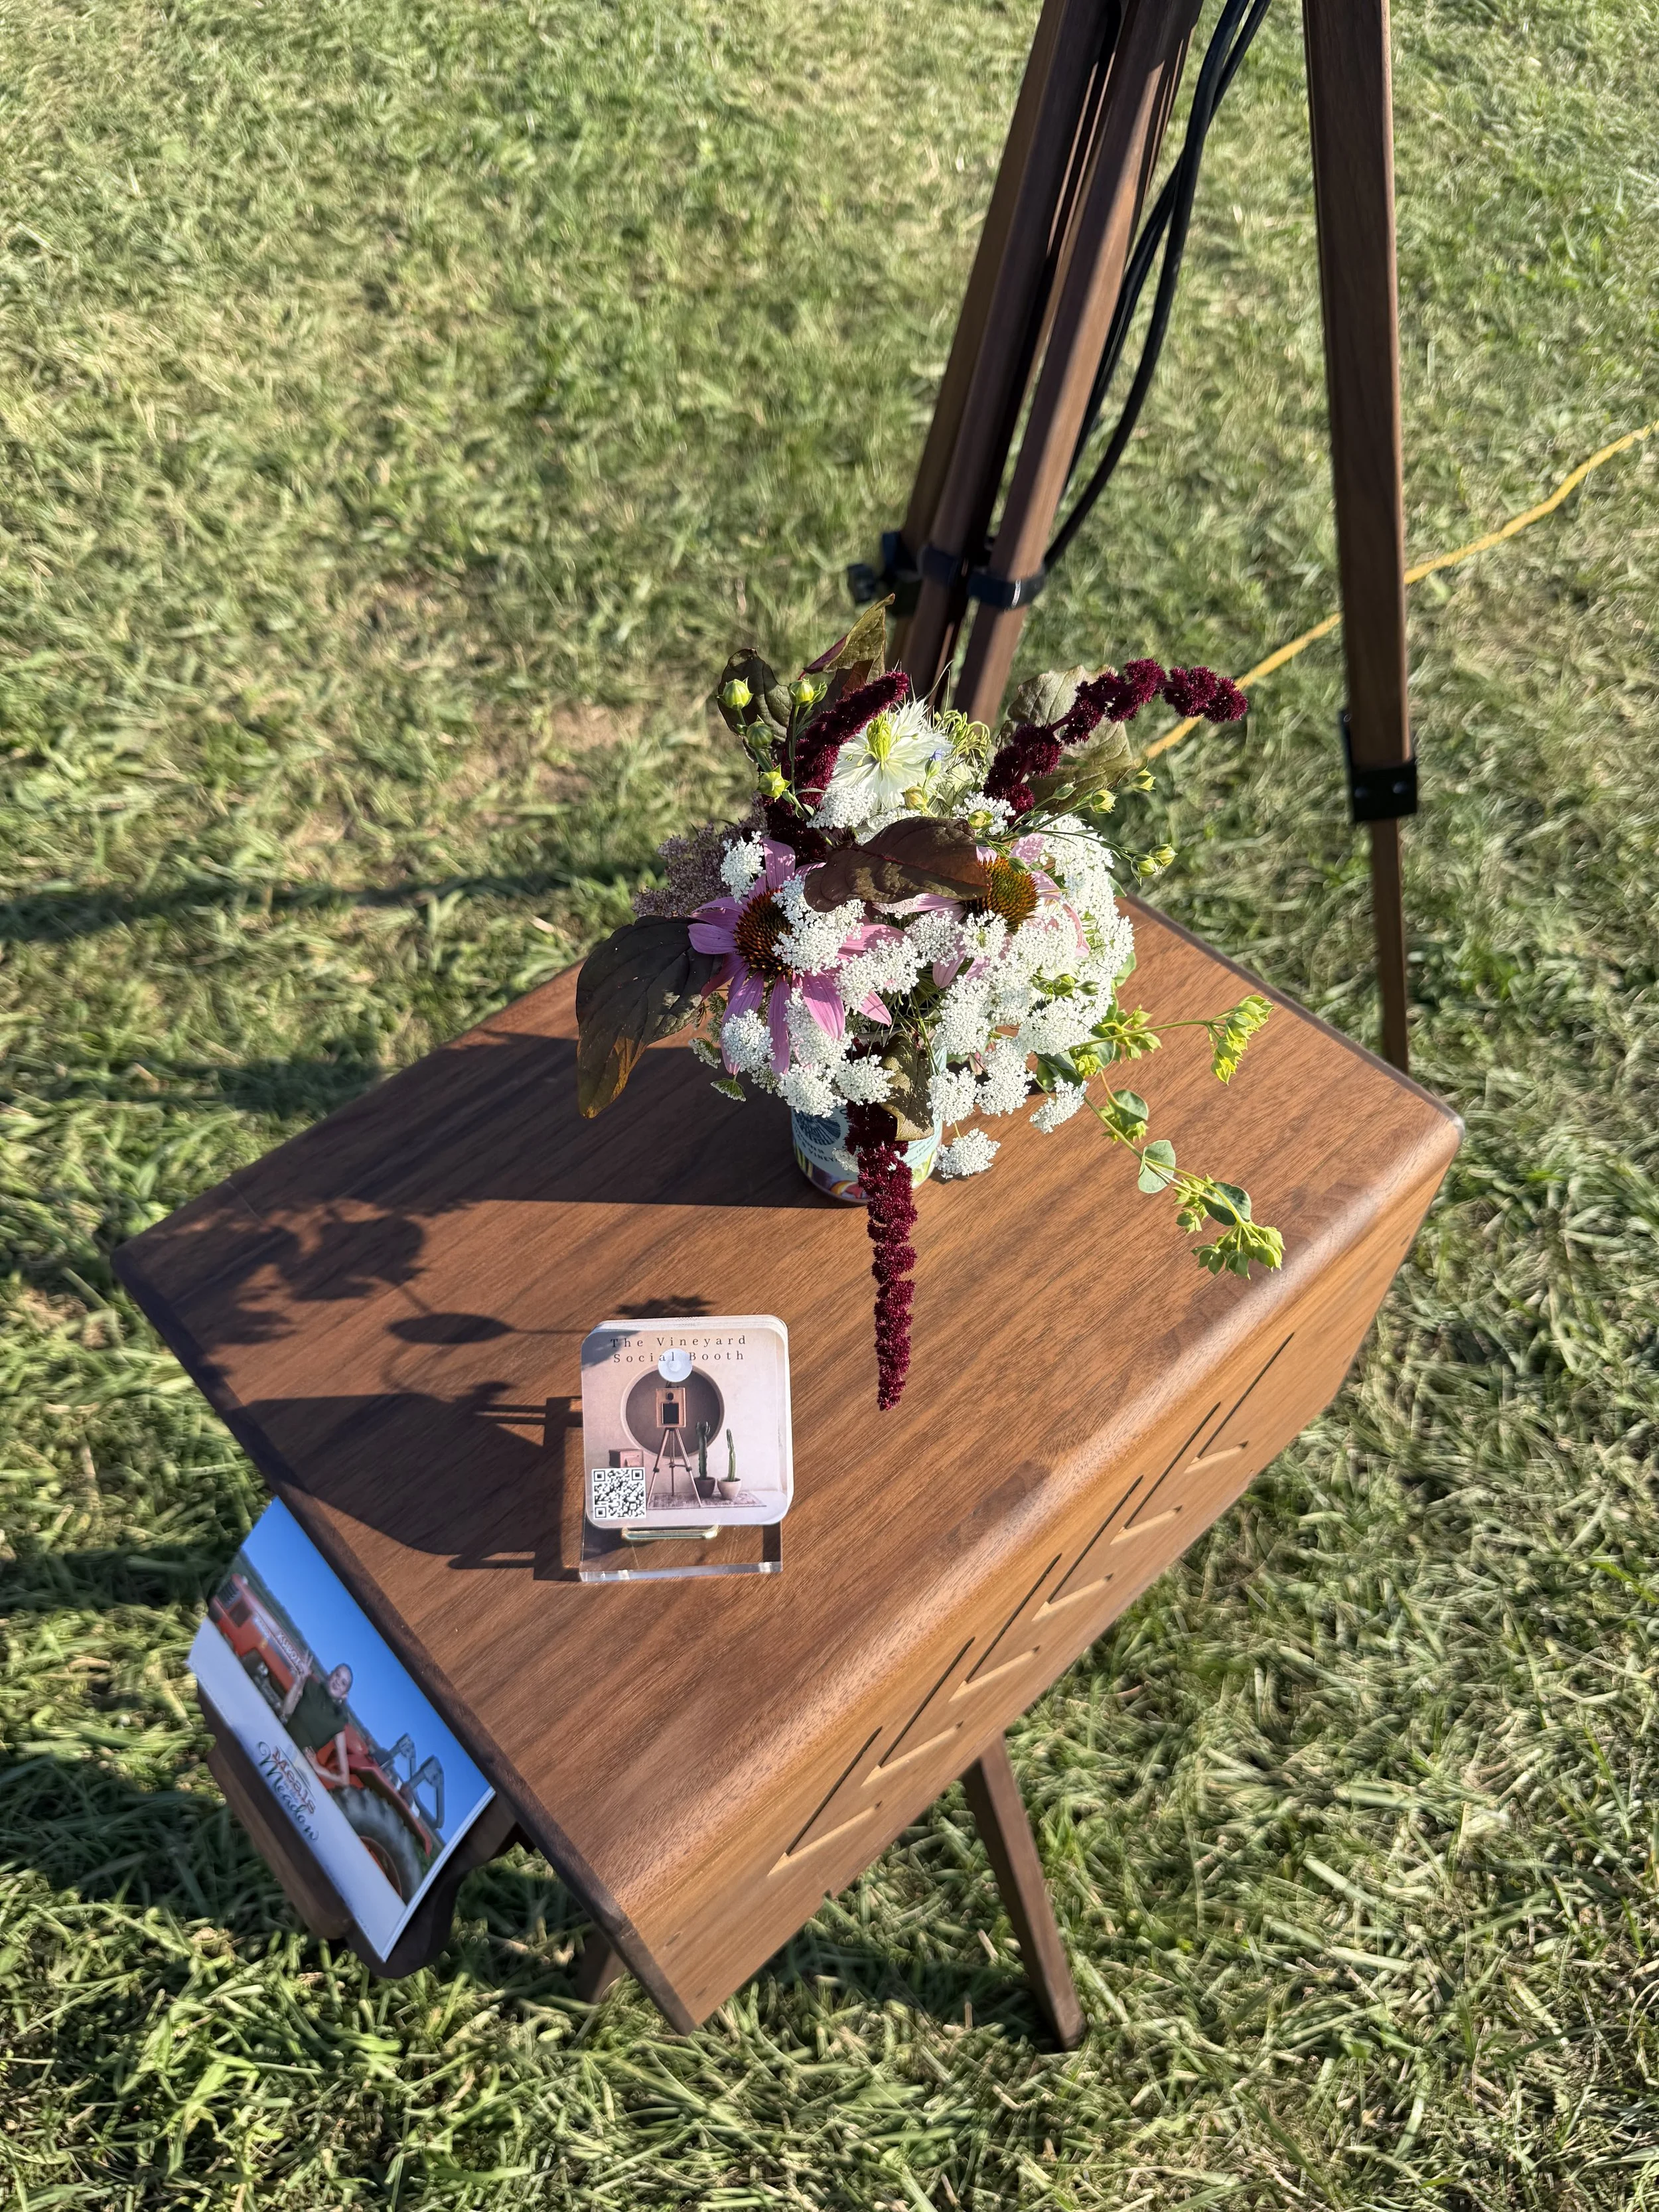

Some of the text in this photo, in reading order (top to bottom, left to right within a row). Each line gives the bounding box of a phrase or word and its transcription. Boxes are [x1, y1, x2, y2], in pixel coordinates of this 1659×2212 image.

[611, 1335, 747, 1348] The Vineyard
[614, 1351, 744, 1363] Social Booth
[257, 1741, 319, 1841] Meadow
